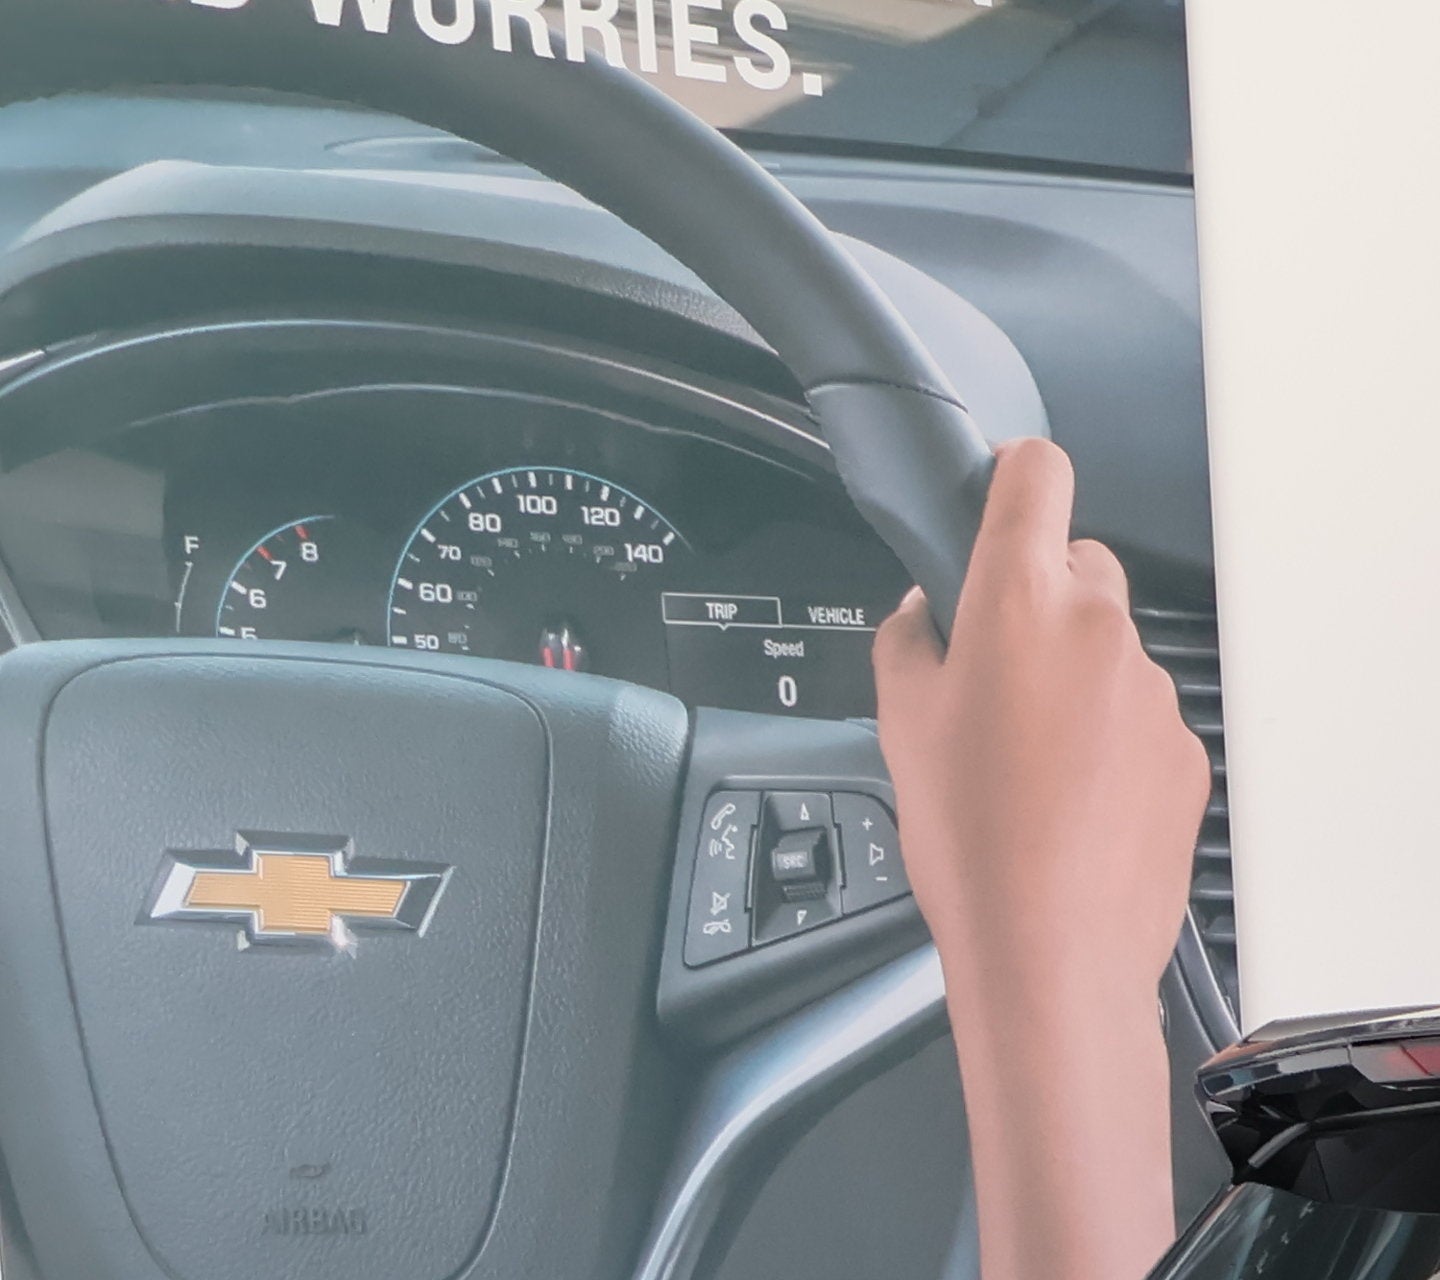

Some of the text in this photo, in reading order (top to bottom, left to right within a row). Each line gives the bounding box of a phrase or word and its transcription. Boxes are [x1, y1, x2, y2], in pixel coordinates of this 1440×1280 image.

[515, 493, 558, 516] 100
[467, 511, 502, 533] 80
[580, 505, 621, 527] 120
[183, 535, 200, 554] F
[301, 542, 319, 562] 8
[437, 544, 462, 561] 70
[624, 542, 664, 564] 140
[269, 560, 287, 581] 7
[249, 588, 267, 609] 6
[418, 582, 452, 604] 60
[704, 601, 866, 626] TRIP VEHICLE
[413, 634, 439, 651] 50
[763, 638, 805, 659] Speed
[778, 675, 798, 708] 0
